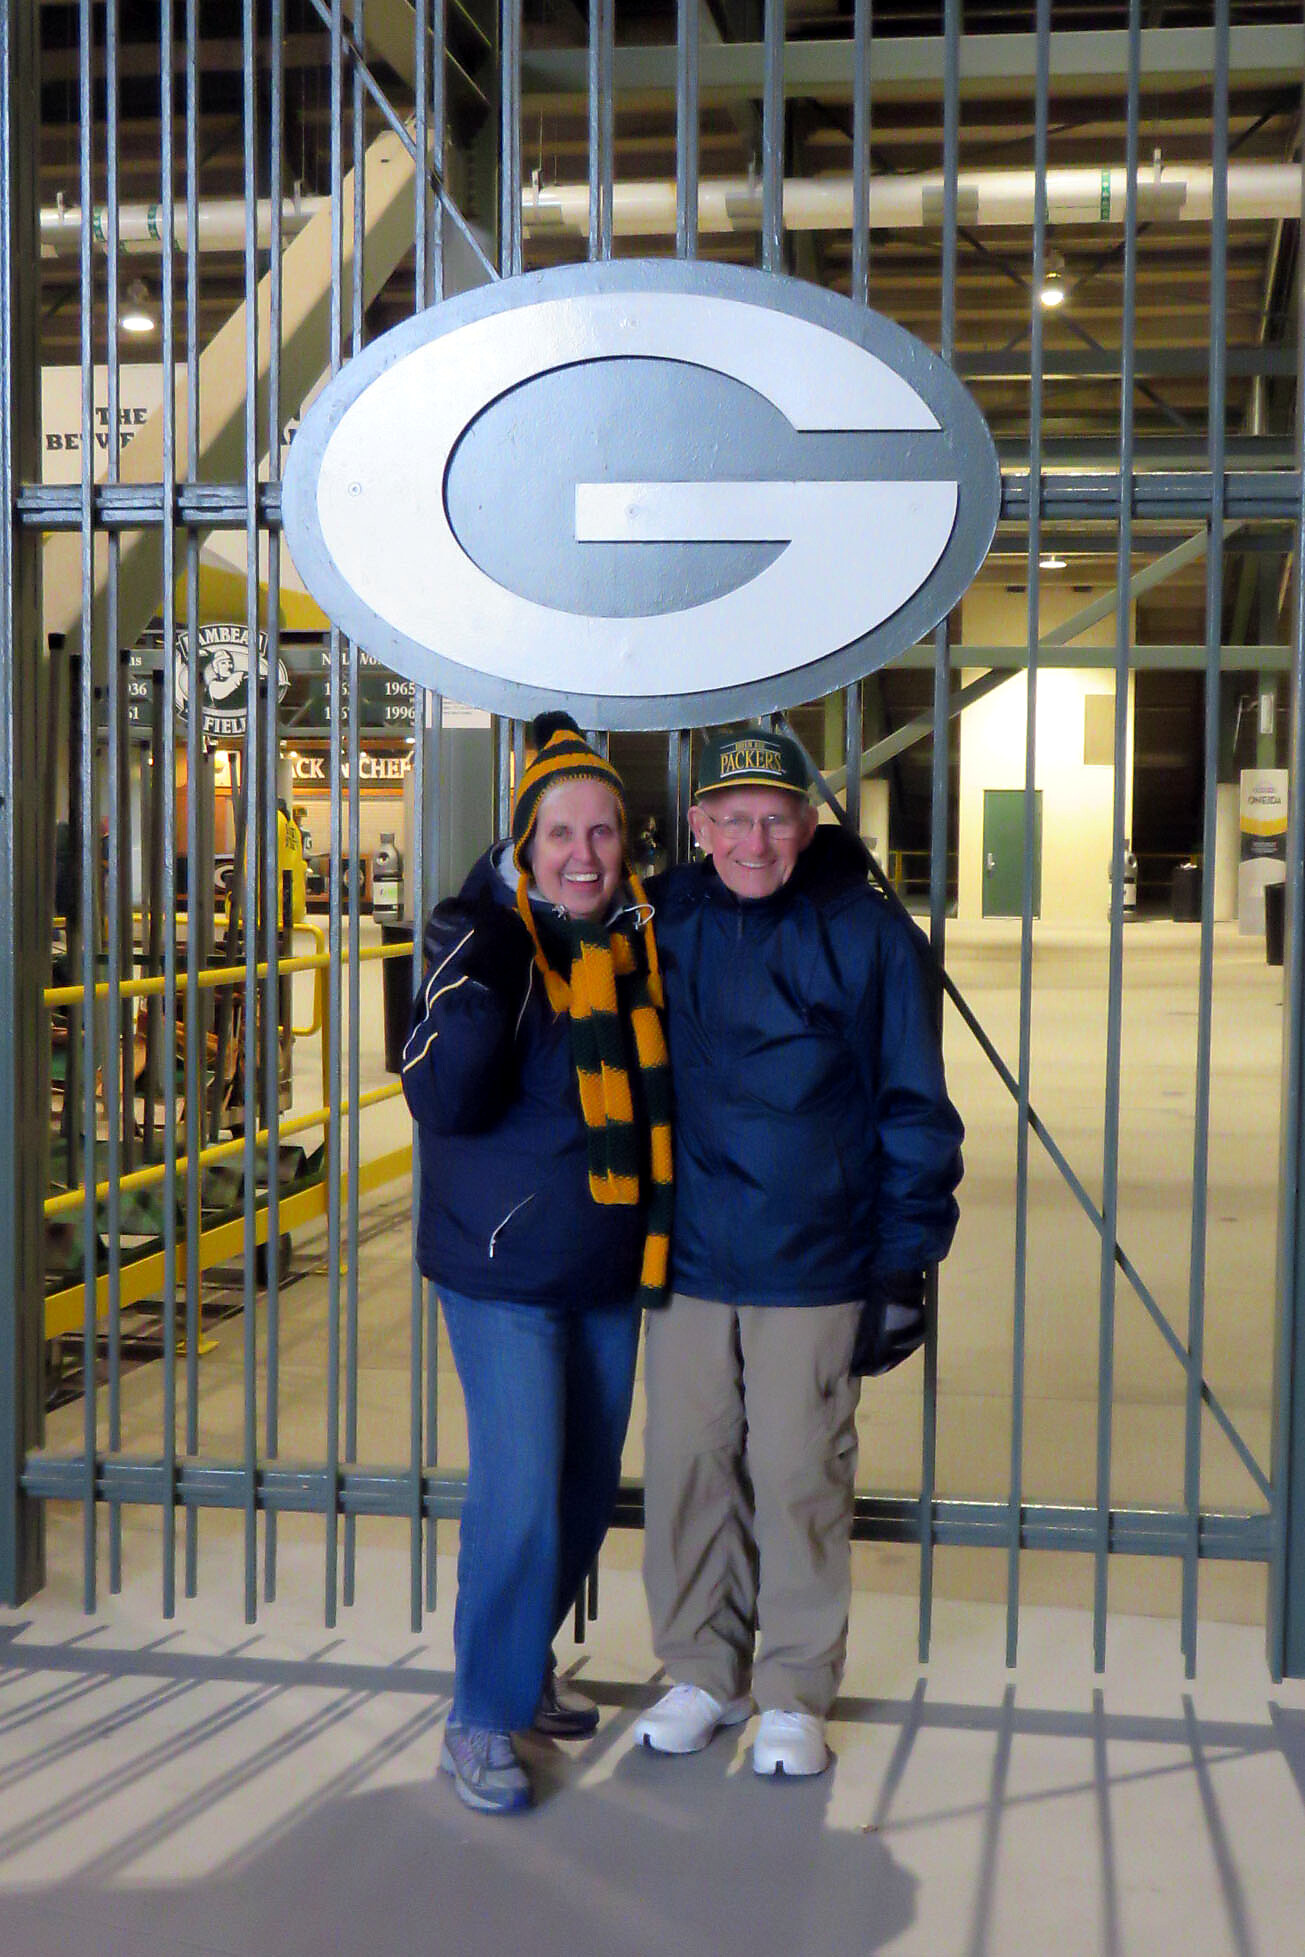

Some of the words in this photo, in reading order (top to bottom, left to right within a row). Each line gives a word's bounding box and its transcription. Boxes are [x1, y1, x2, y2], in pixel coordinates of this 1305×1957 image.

[95, 407, 147, 425] THE
[317, 292, 958, 697] G
[385, 682, 416, 696] 1965
[385, 706, 416, 720] 1996
[202, 716, 247, 734] FIEL
[720, 750, 783, 775] PACKERS
